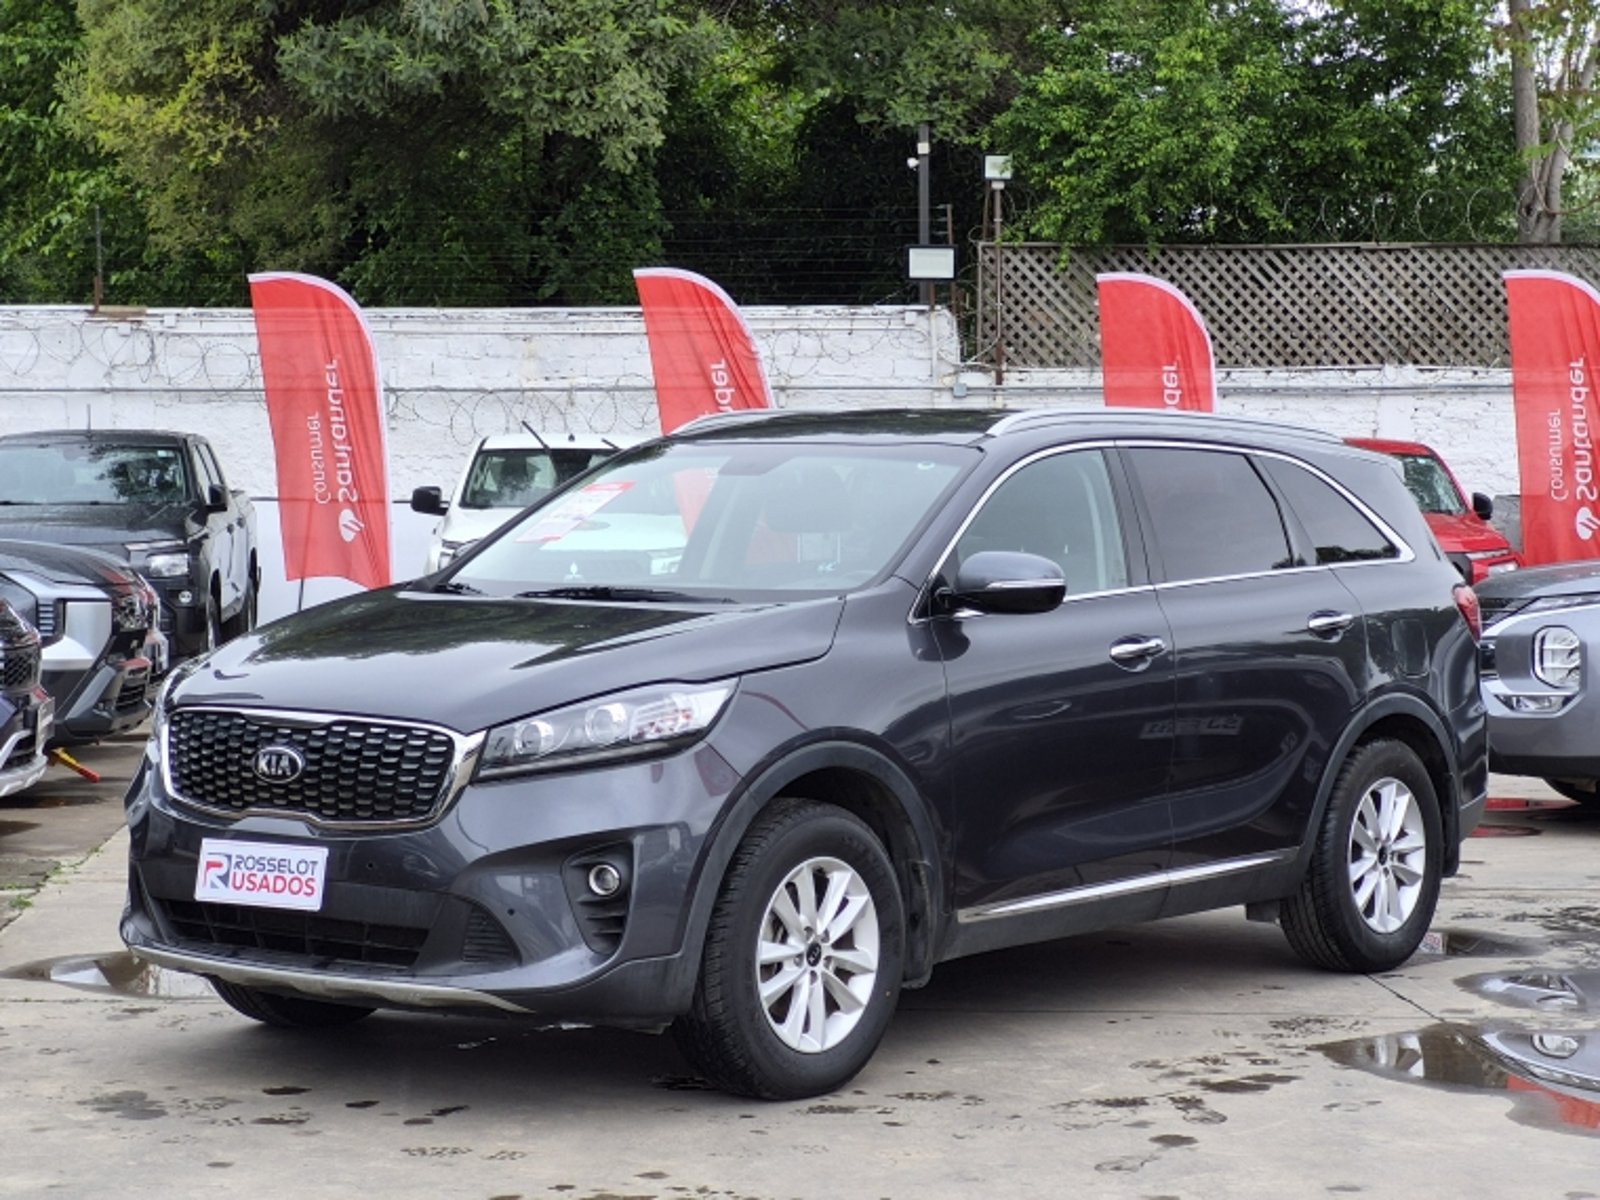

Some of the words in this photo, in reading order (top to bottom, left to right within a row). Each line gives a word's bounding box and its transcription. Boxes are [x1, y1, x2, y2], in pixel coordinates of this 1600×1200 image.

[258, 753, 291, 776] KIA
[233, 854, 318, 876] ROSSELOT
[231, 872, 316, 897] USADOS
